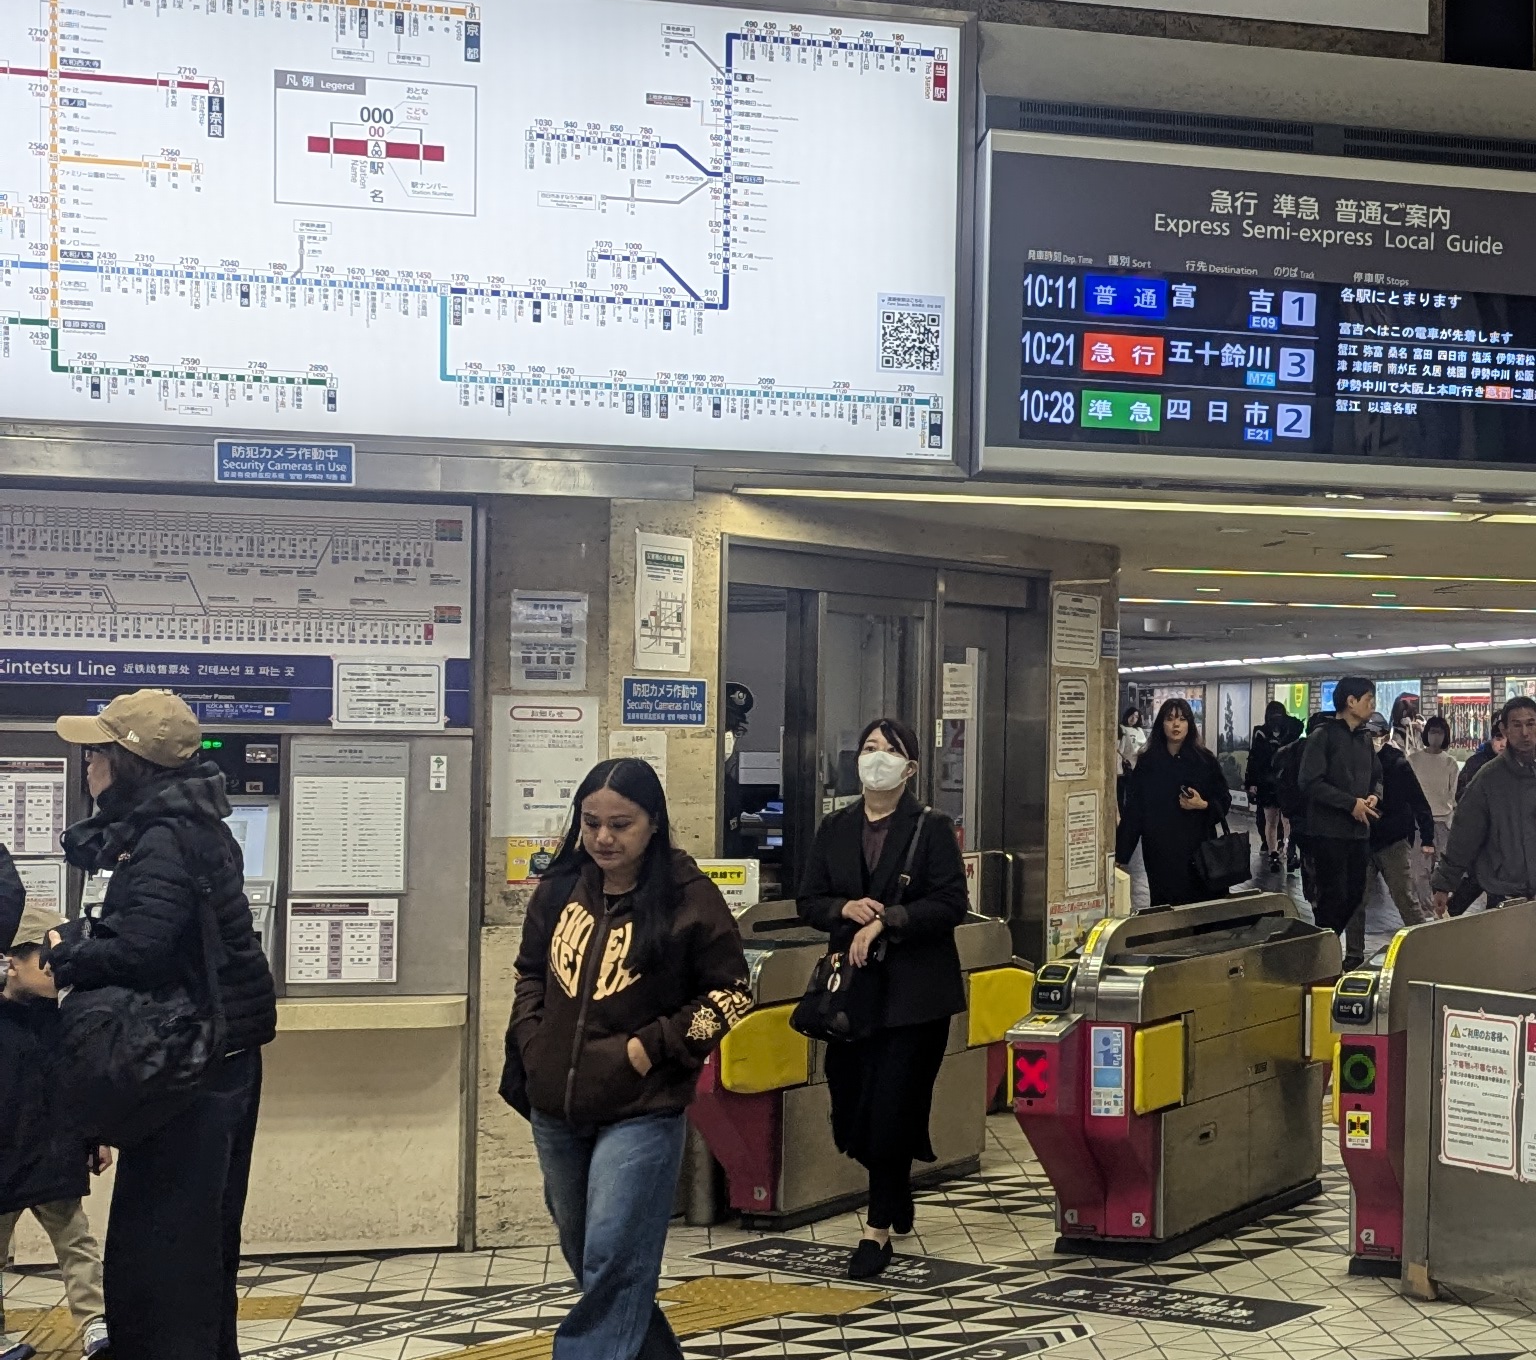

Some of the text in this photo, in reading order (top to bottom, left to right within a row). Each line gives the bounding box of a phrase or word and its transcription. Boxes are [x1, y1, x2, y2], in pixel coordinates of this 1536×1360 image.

[466, 23, 479, 60] 京都
[285, 74, 355, 91] 凡例 Legend
[934, 64, 946, 99] 当駅
[406, 87, 428, 95] おとな
[360, 107, 393, 124] 000
[406, 107, 428, 115] こども
[369, 126, 384, 137] 00
[1210, 190, 1450, 230] 急行 準急 普通ご案内
[1154, 213, 1503, 255] Express Semi-express Local Guide
[1108, 255, 1409, 287] 種別 Sort Destination のりば 停車駅 Stops
[1023, 273, 1305, 322] 10:11 普通 富吉 1
[1340, 288, 1461, 309] 各駅にとまります
[1252, 317, 1276, 329] E09
[1339, 322, 1513, 344] 富吉へはこの電車が先着します
[1022, 331, 1306, 378] 10:21 急行 五十鈴川 3
[1437, 350, 1468, 363] 四日市
[1250, 374, 1273, 385] M75
[1387, 363, 1417, 375] 南が丘
[1471, 367, 1510, 381] 伊勢中川
[1020, 389, 1303, 433] 10:28 準急 四日市 2
[1247, 429, 1269, 440] E21
[232, 446, 338, 461] 防犯カメラ作動中
[223, 459, 346, 472] Security Cameras in Use
[77, 660, 116, 676] Line
[258, 665, 280, 676] 파는
[633, 683, 697, 698] 防犯カメラ作動中
[1462, 1028, 1509, 1043] ご利用のお客様へ
[1069, 1211, 1141, 1225] 1 2
[1364, 1231, 1371, 1242] 2
